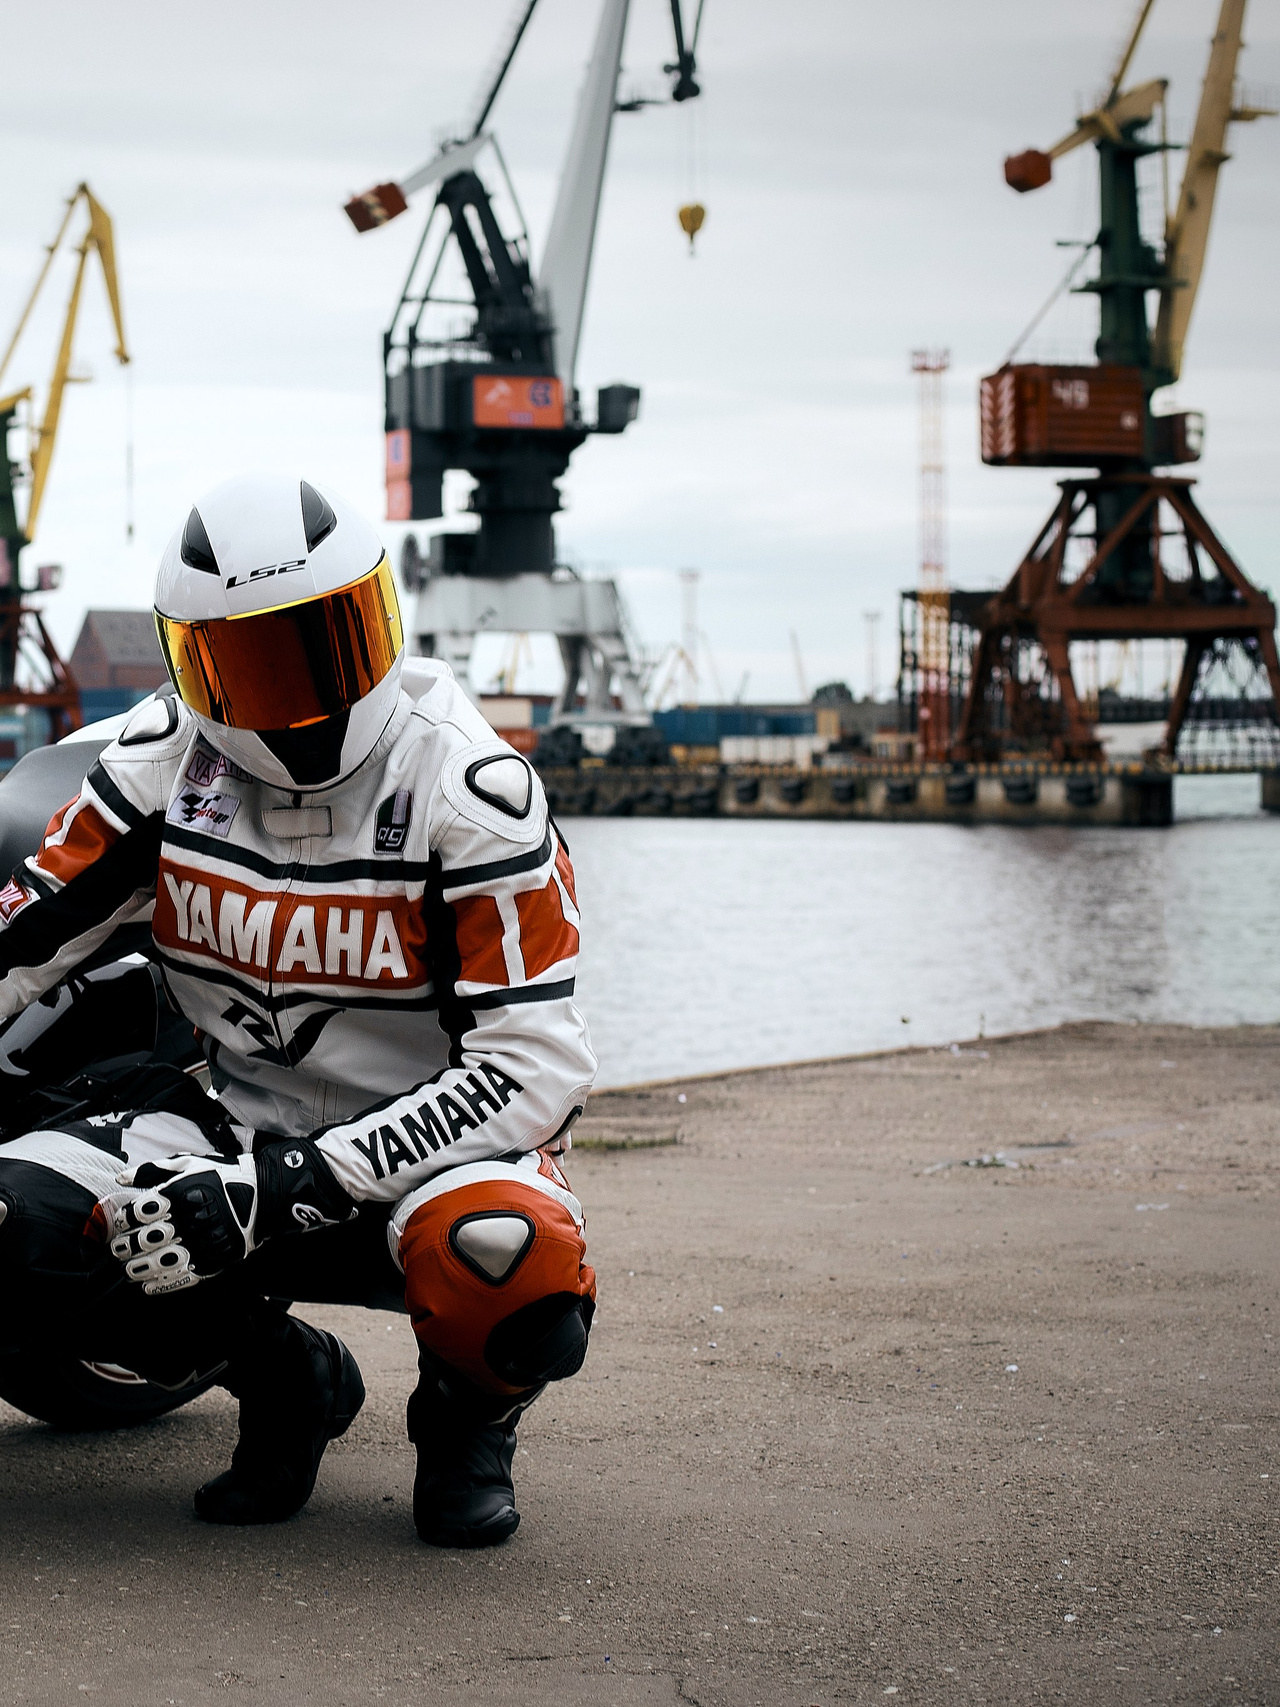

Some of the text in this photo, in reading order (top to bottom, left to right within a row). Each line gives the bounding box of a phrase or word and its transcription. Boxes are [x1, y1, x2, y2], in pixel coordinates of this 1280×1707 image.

[226, 559, 306, 590] LS2
[163, 872, 409, 980] YAMAHA
[350, 1062, 524, 1181] YAMAHA
